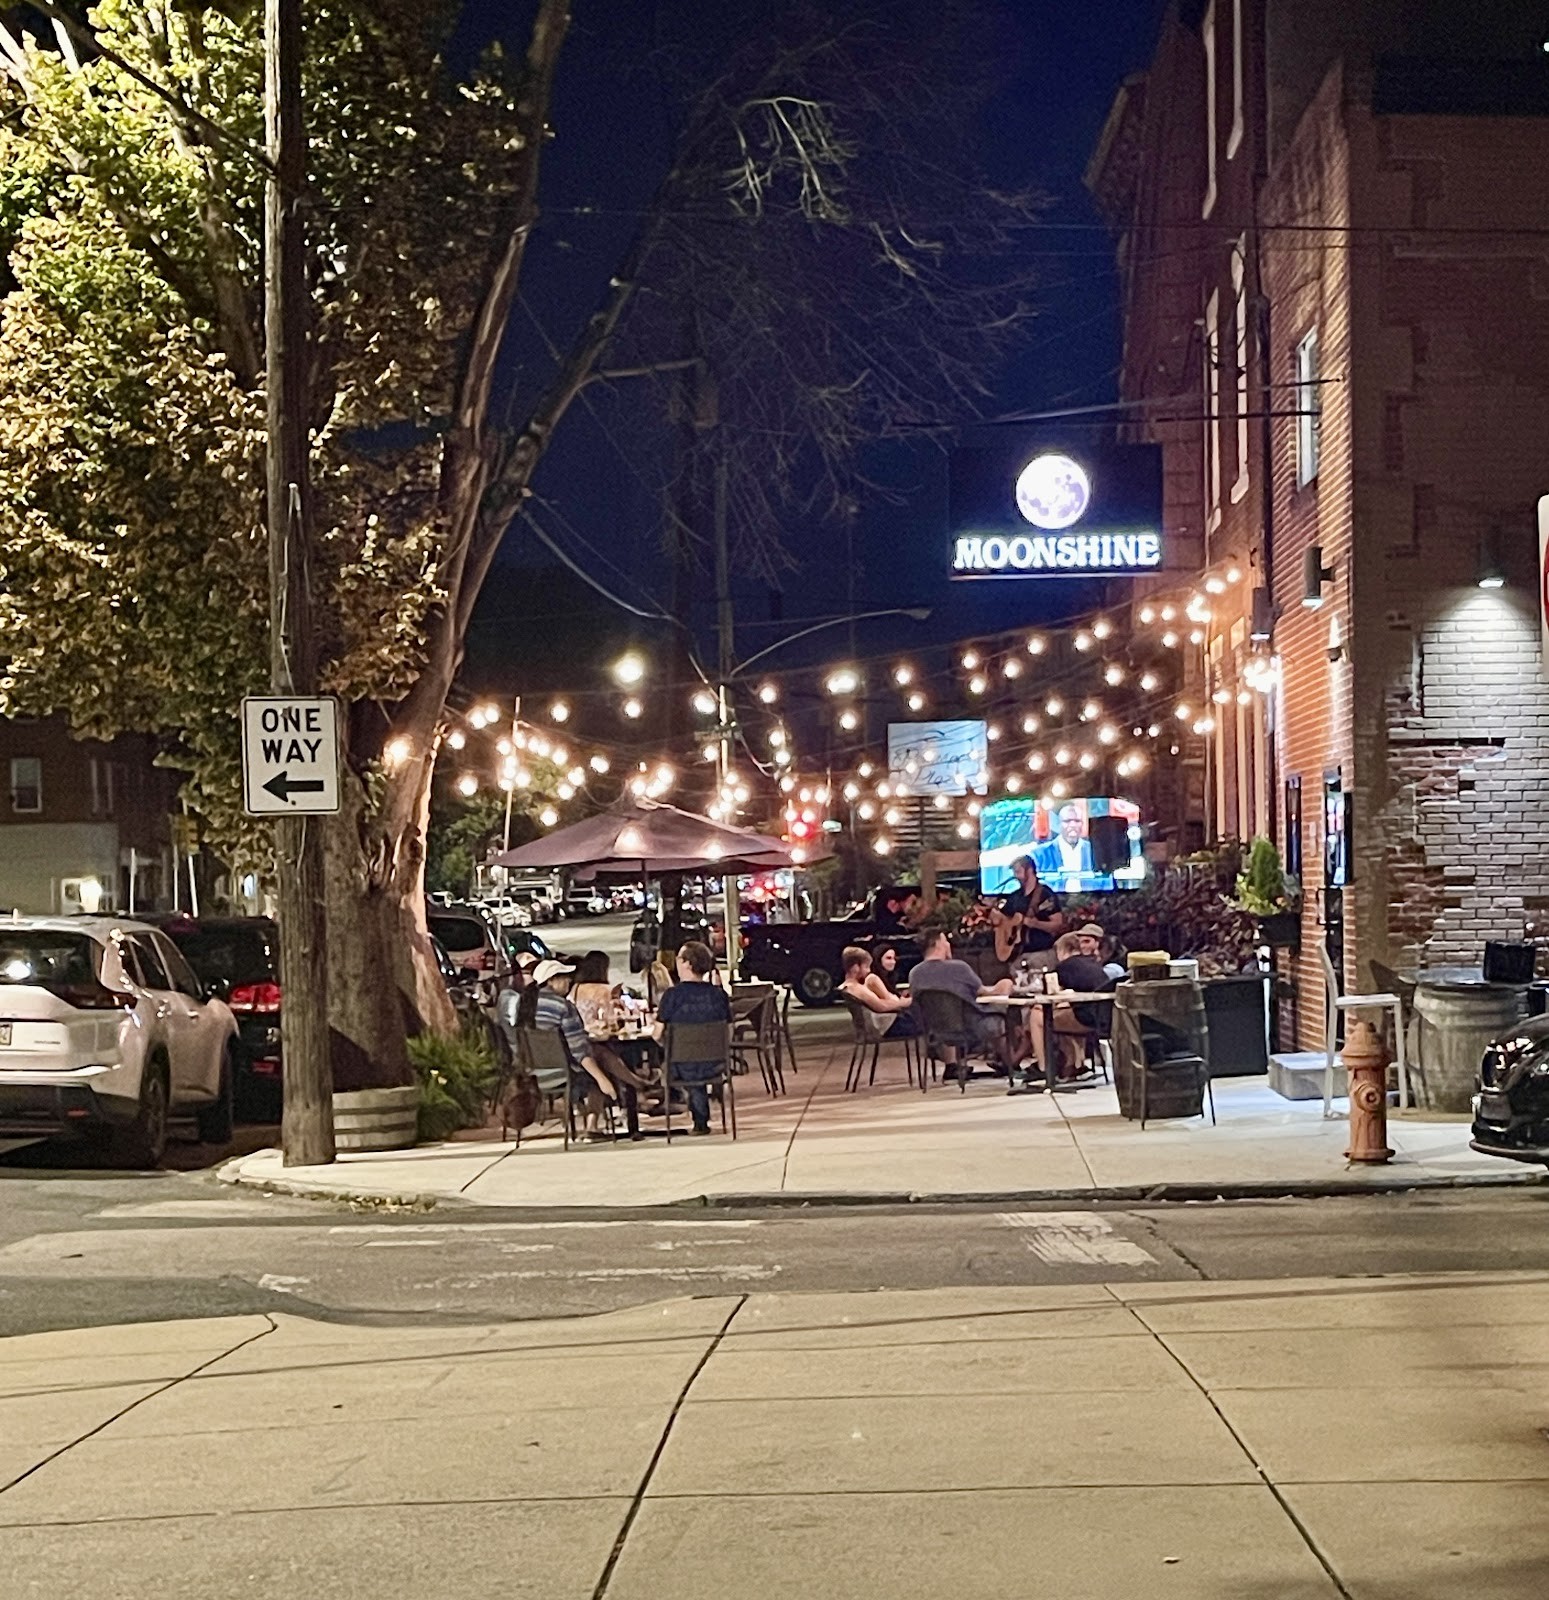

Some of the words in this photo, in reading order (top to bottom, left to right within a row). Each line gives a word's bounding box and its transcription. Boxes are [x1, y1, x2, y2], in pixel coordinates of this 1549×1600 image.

[953, 534, 1160, 569] MOONSHINE
[262, 708, 321, 732] ONE
[261, 739, 322, 763] WAY
